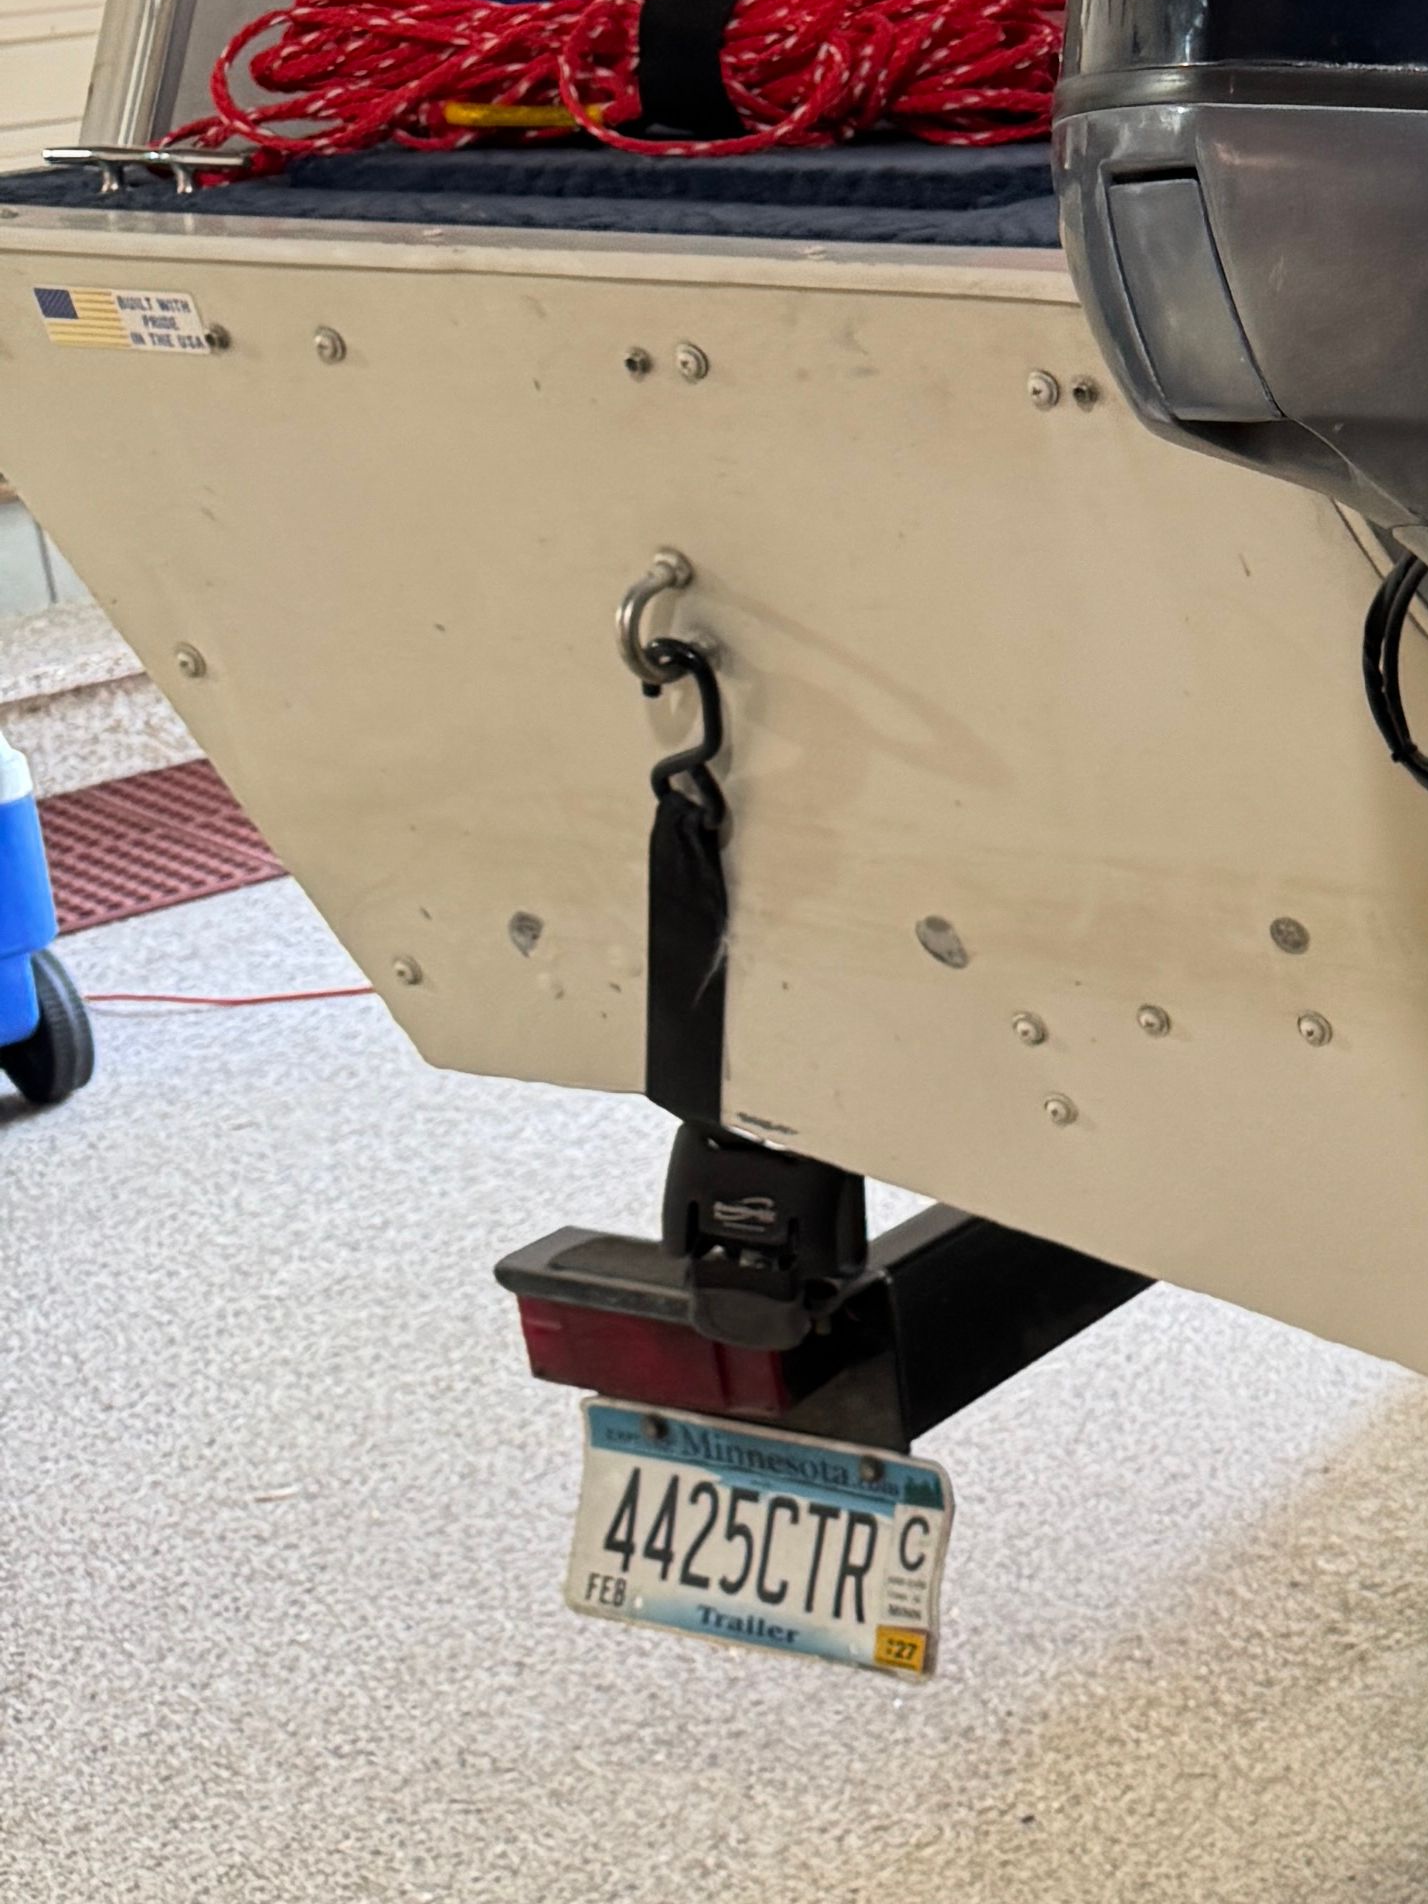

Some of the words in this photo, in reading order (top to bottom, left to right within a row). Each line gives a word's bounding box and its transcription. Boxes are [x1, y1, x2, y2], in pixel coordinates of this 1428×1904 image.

[116, 295, 152, 311] BUILT
[156, 297, 191, 313] WITH
[141, 314, 179, 331] PRIDE
[148, 332, 175, 347] THE
[177, 333, 207, 349] USA
[603, 1466, 879, 1624] 4425CTR
[898, 1515, 931, 1572] C
[584, 1573, 628, 1608] FEB
[696, 1603, 801, 1645] Trailer
